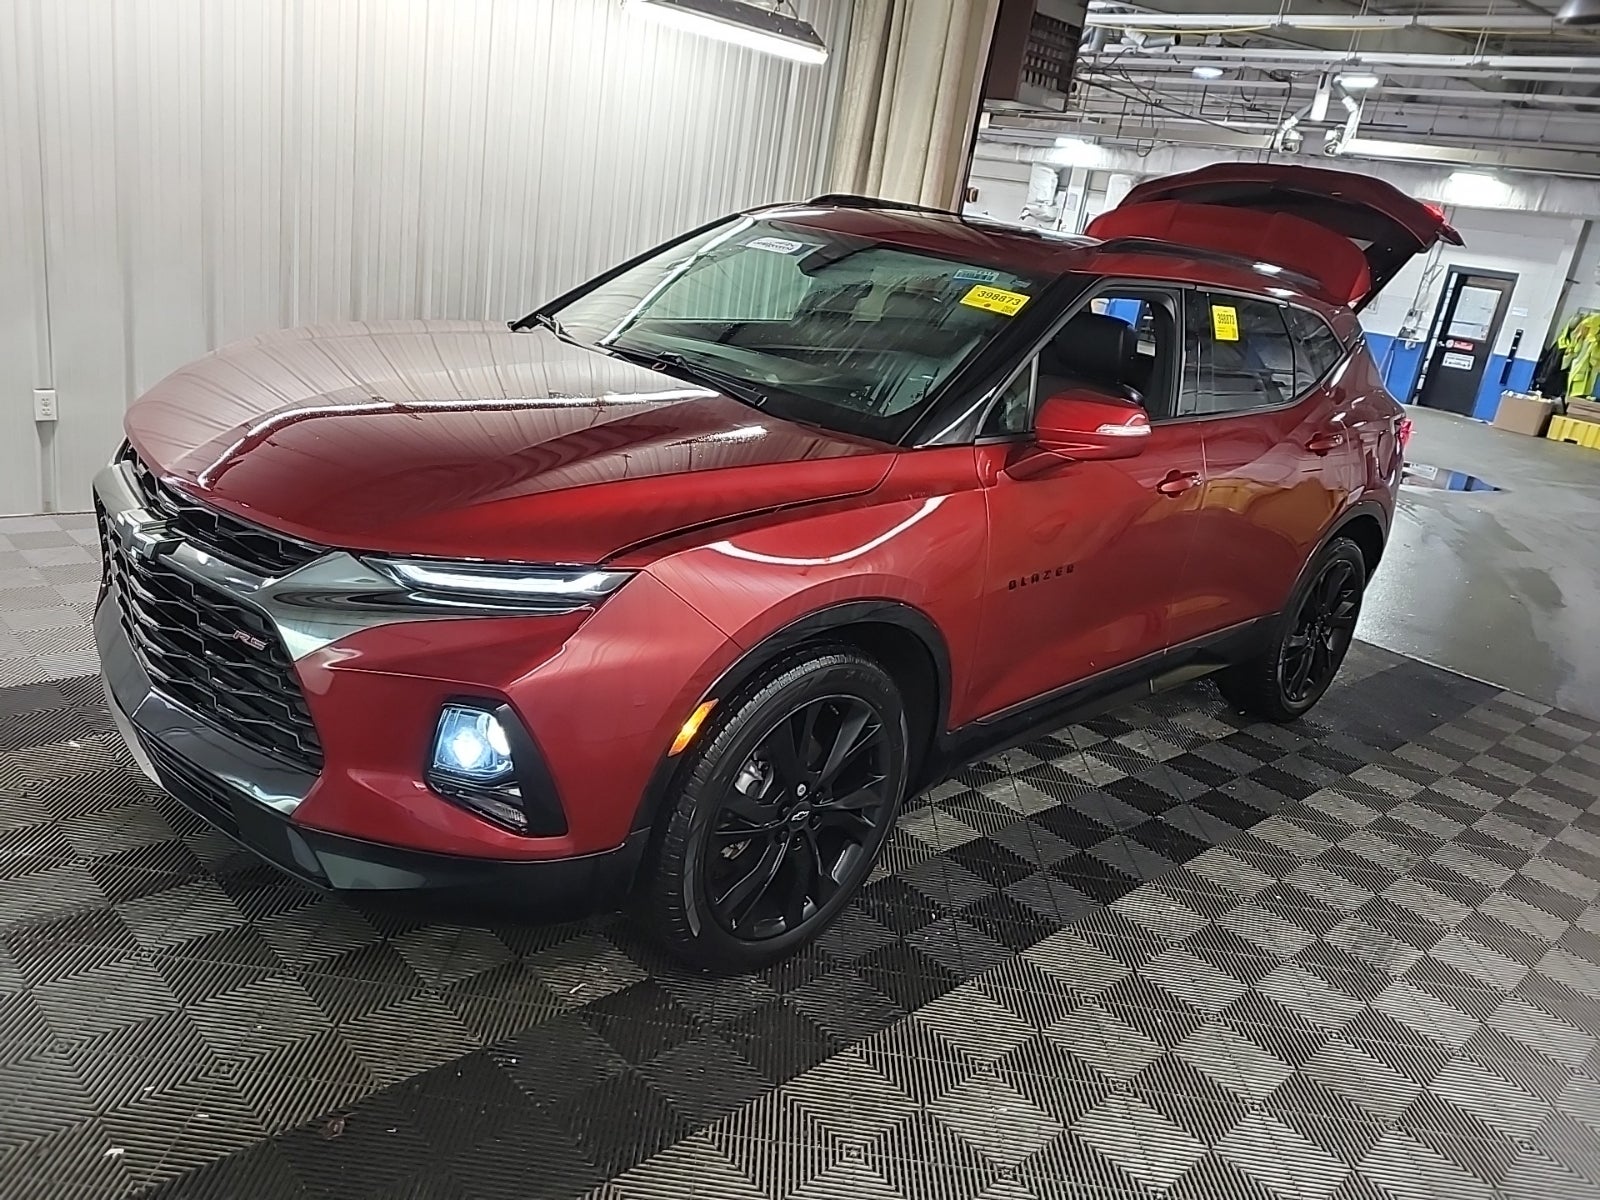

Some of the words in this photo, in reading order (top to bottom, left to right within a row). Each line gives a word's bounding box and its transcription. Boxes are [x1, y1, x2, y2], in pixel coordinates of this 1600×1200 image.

[977, 290, 1021, 306] 398873
[1008, 564, 1074, 590] BLAZER
[232, 630, 268, 651] RS
